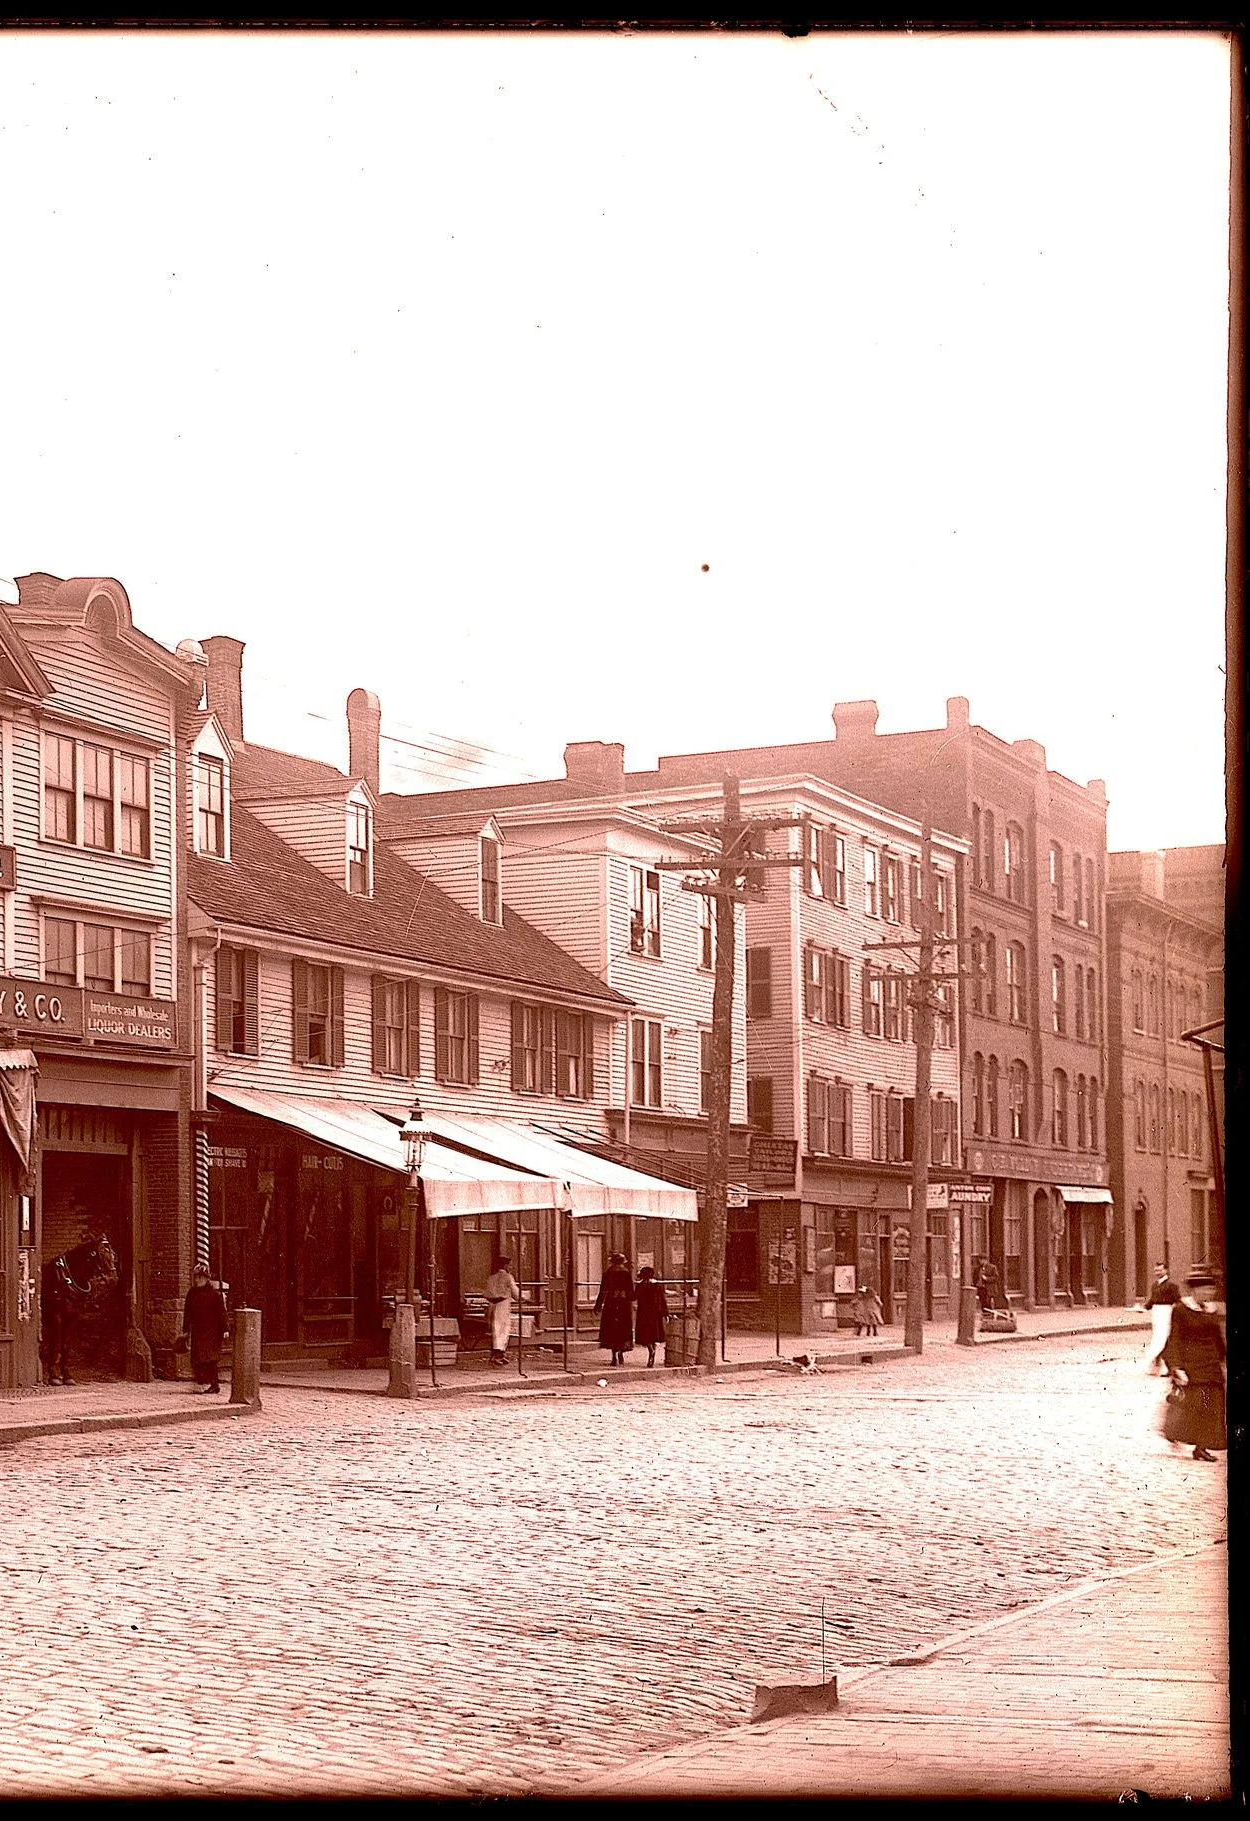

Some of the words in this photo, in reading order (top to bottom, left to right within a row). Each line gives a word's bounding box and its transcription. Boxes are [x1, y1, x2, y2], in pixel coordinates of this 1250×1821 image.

[14, 991, 29, 1018] &
[35, 994, 66, 1022] CO.
[90, 999, 122, 1016] Importers
[123, 1005, 137, 1017] and
[137, 1005, 169, 1021] Wholesale
[88, 1018, 126, 1034] LIQUOR
[128, 1023, 172, 1040] DEALERS
[951, 1191, 990, 1202] AUNDRY
